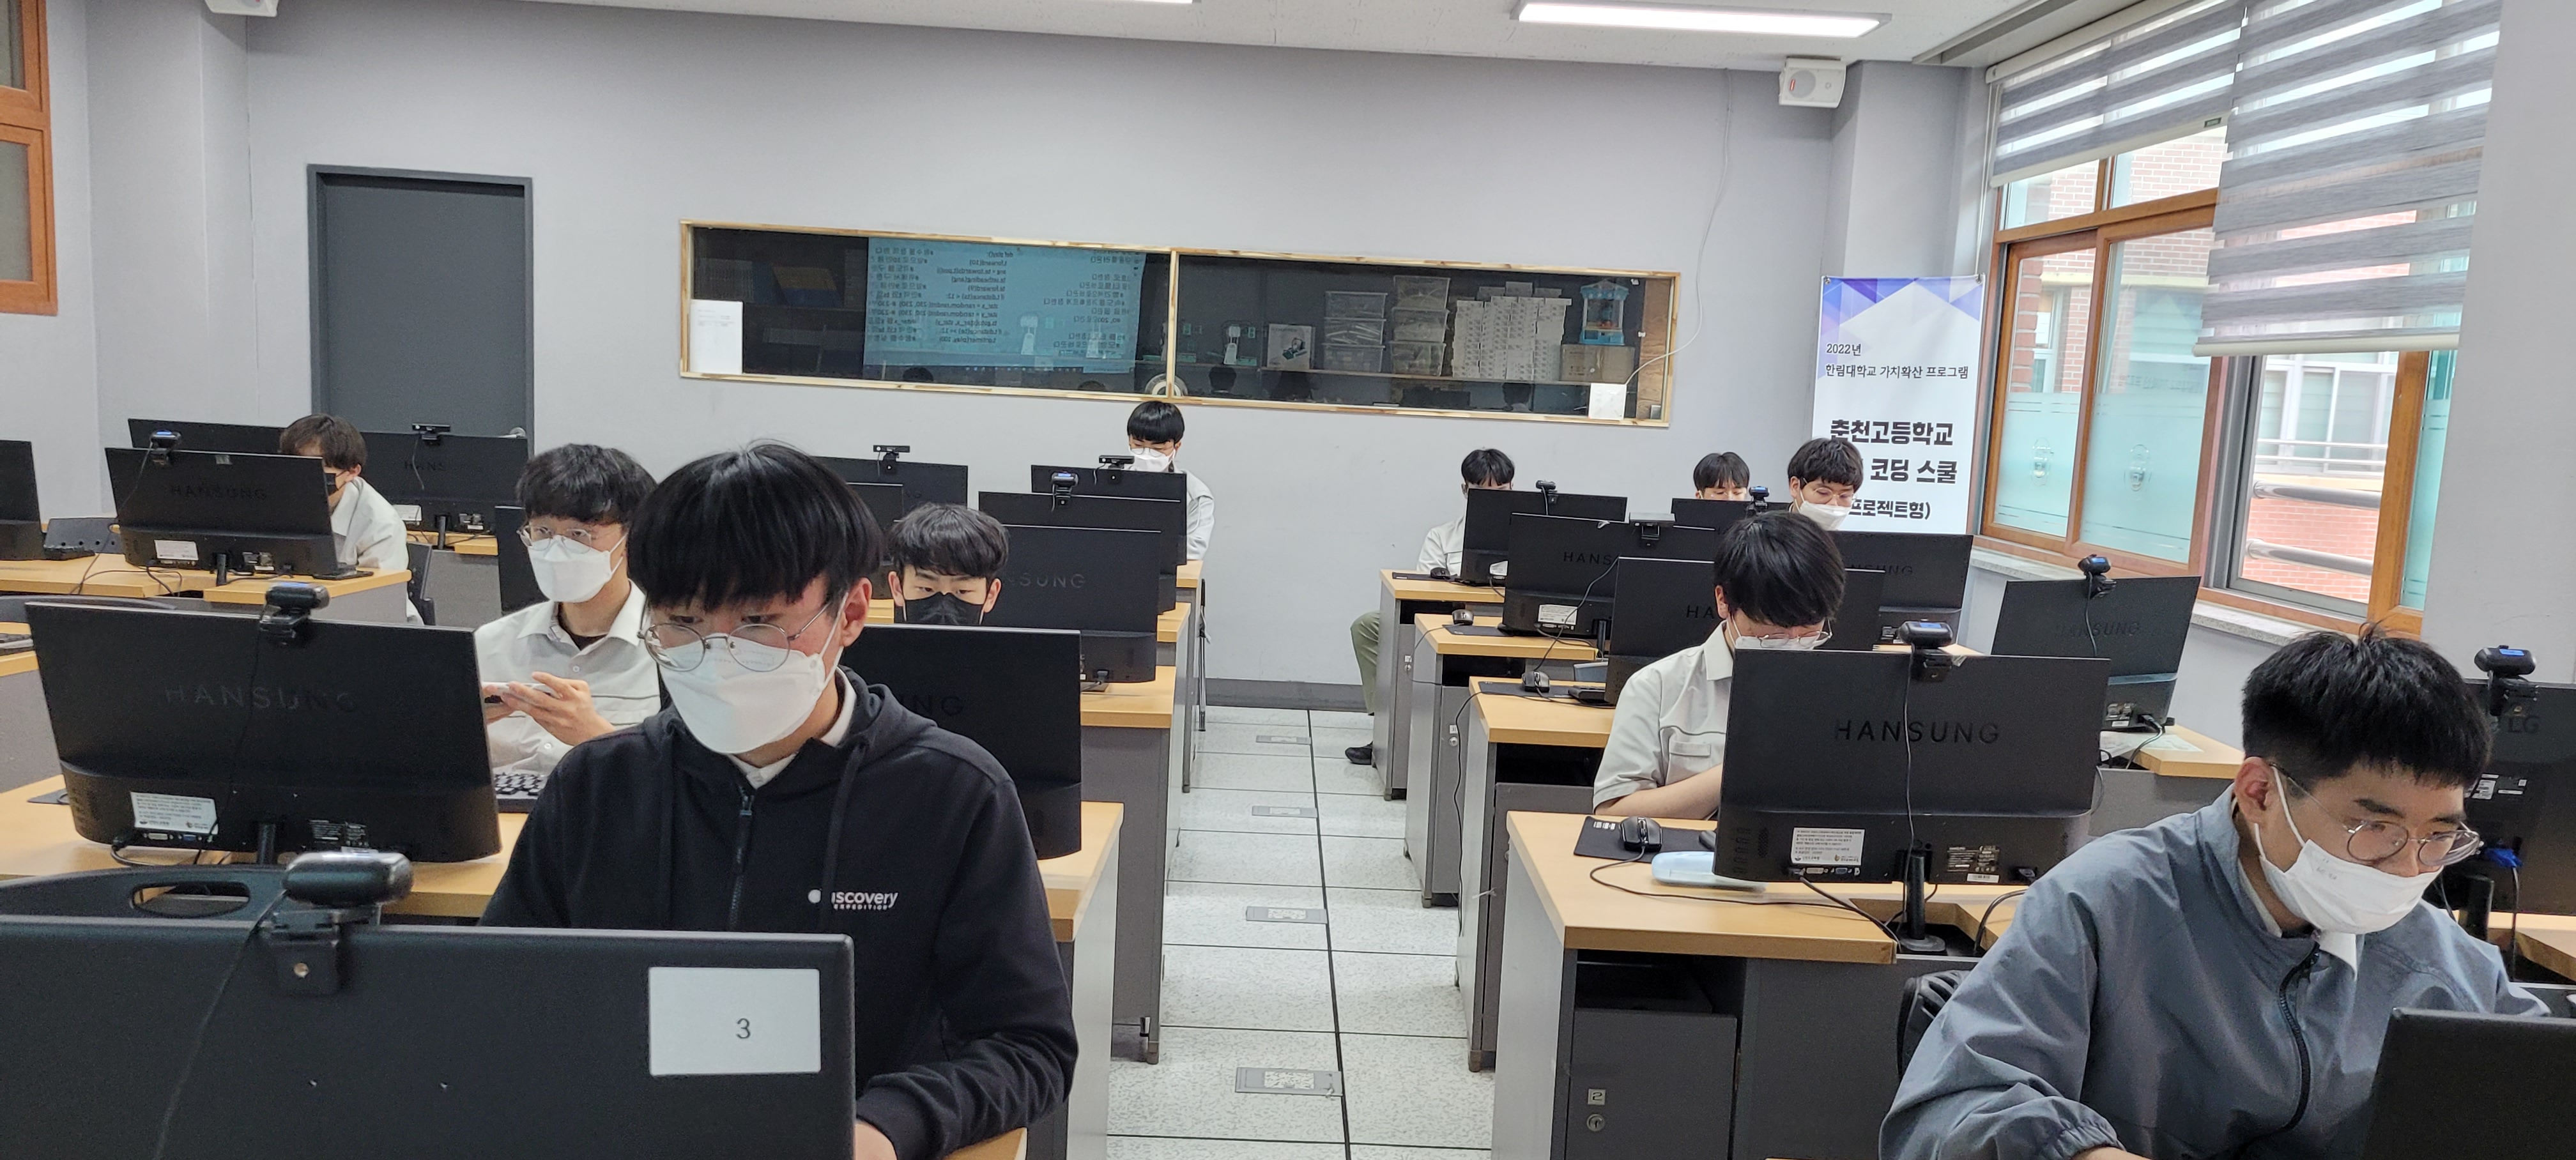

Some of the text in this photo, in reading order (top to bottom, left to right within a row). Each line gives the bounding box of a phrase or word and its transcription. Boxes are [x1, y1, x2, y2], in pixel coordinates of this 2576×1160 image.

[1826, 343, 1861, 356] 2022년
[1825, 363, 1969, 379] 한림대학교 가치확산 프로그램
[1830, 419, 1954, 446] 춘천고등학교
[1870, 459, 1958, 485] 코딩 스쿨
[1848, 498, 1932, 520] 프로젝트형)
[165, 684, 358, 713] HANSUNG
[1837, 720, 2000, 744] HANSUNG
[2508, 715, 2540, 733] LG
[737, 1018, 751, 1039] 3
[1592, 1092, 1603, 1101] 2
